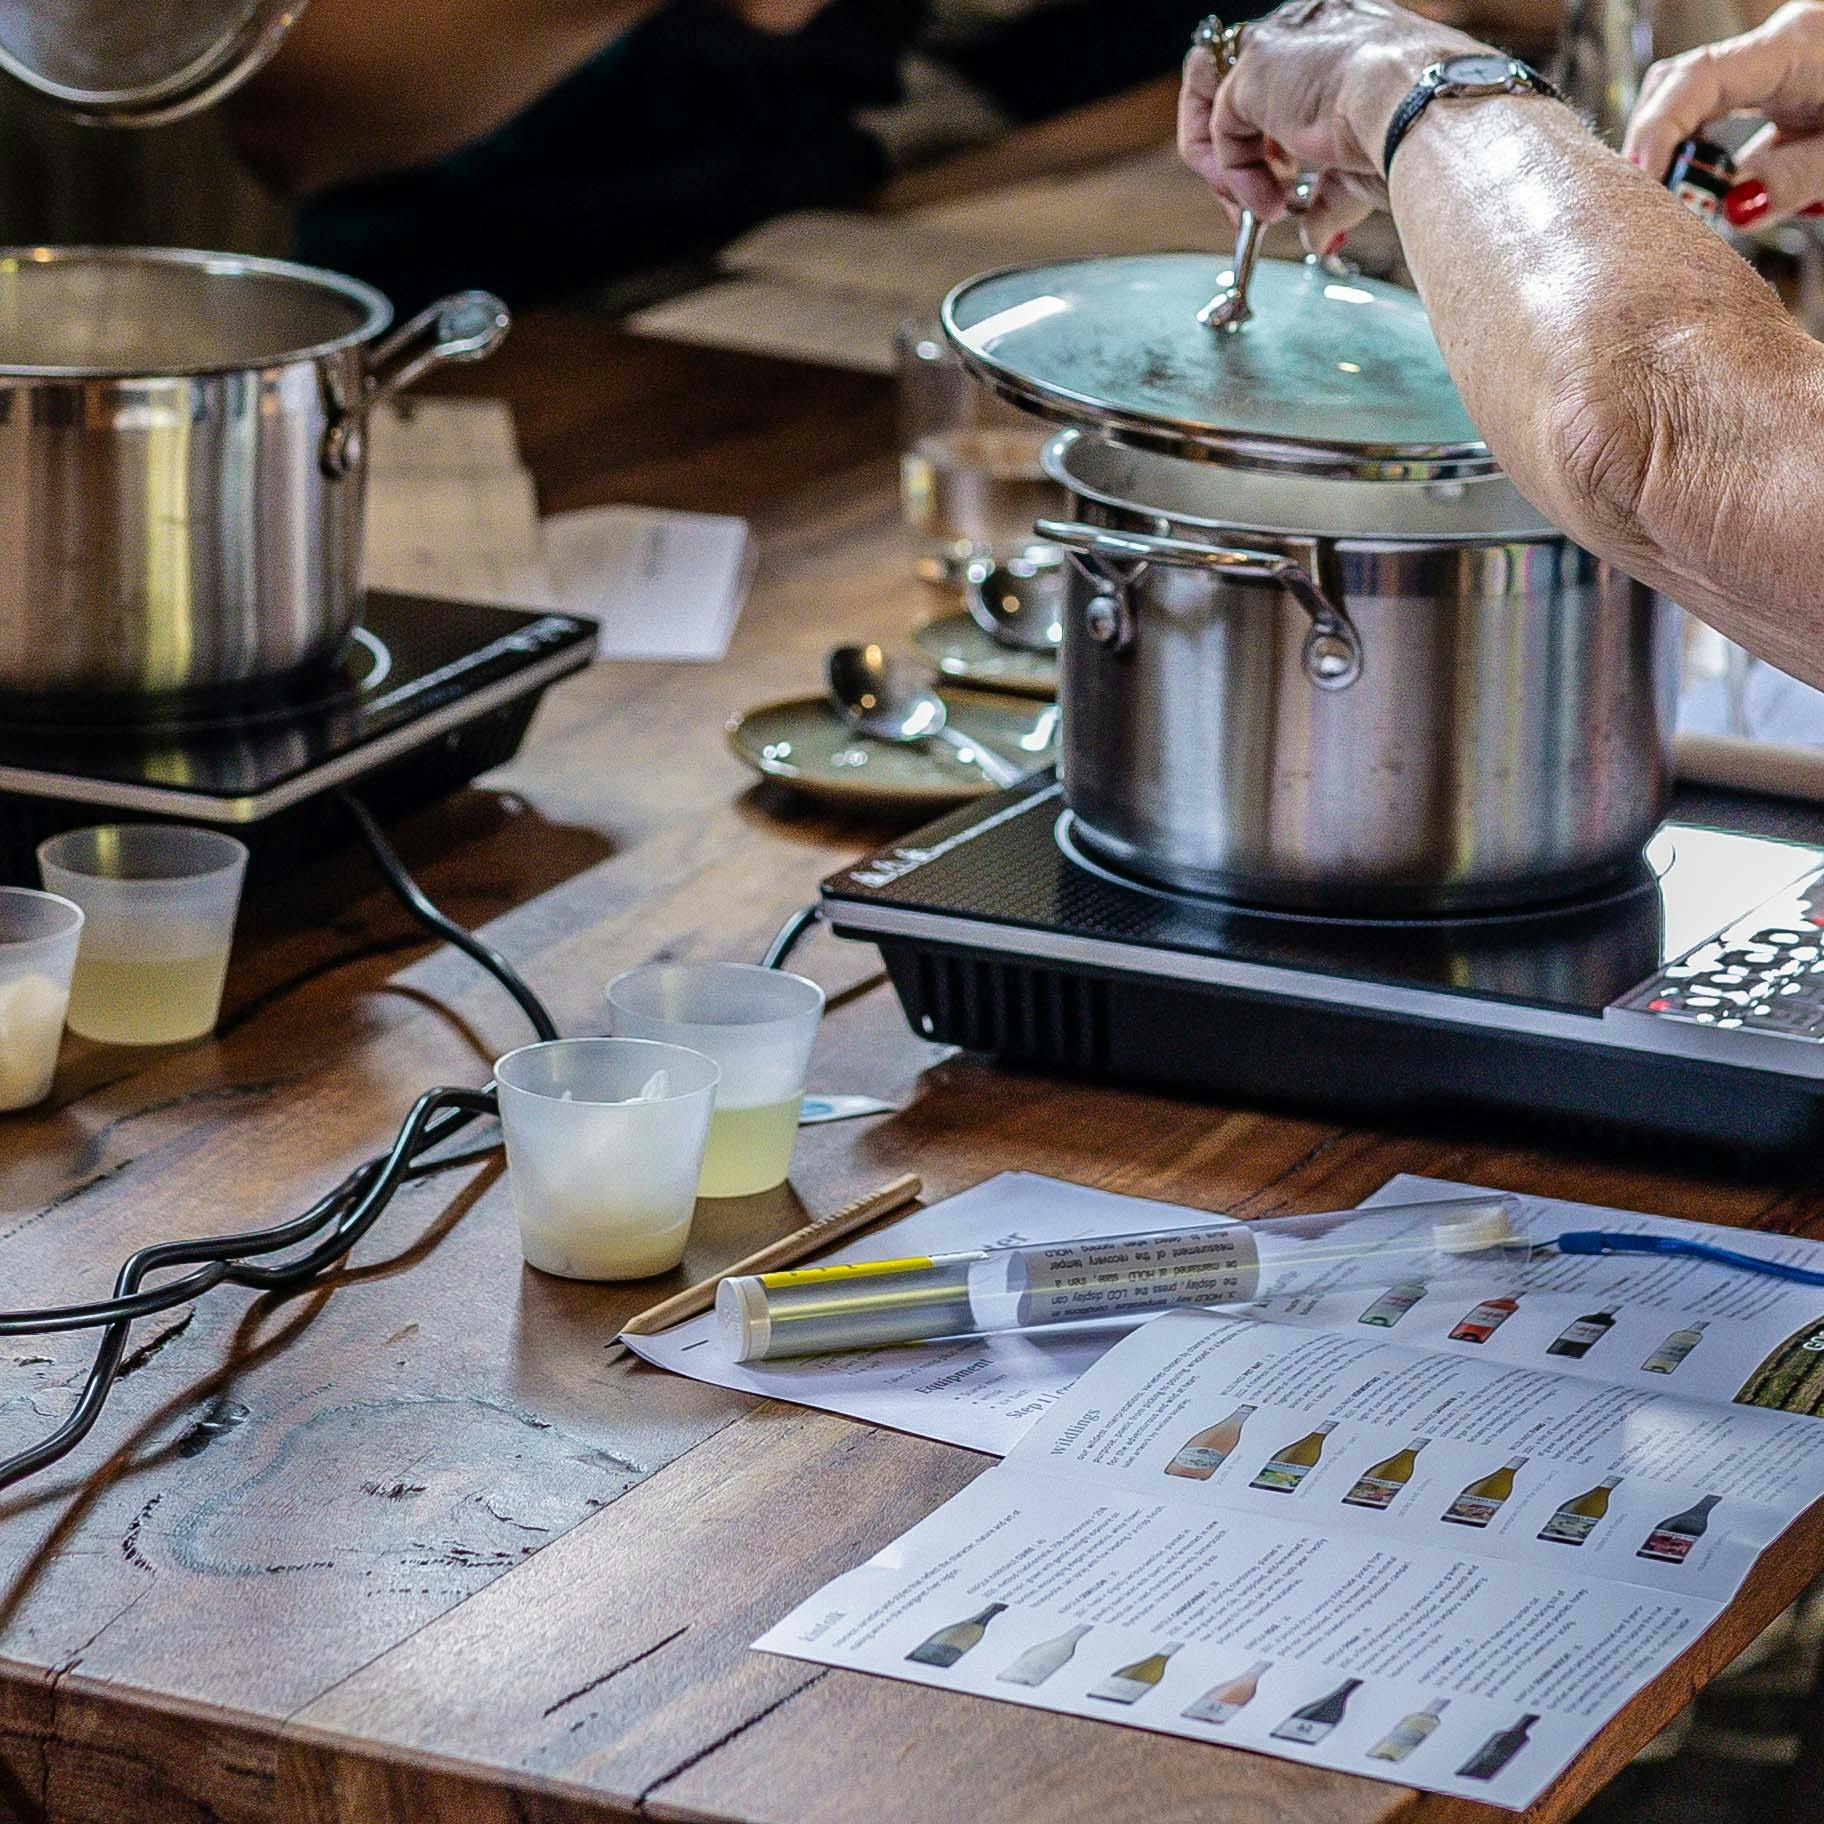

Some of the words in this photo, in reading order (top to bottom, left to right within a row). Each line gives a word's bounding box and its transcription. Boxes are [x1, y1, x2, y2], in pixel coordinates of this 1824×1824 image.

[1172, 1243, 1234, 1257] measurement
[1088, 1254, 1129, 1267] recovery
[1134, 1252, 1151, 1263] the
[1051, 1295, 1069, 1305] can
[1072, 1290, 1104, 1303] display
[1107, 1289, 1128, 1301] LCD
[915, 1358, 994, 1396] Equipment
[1005, 1402, 1044, 1419] Step
[1050, 1408, 1101, 1455] wildlings
